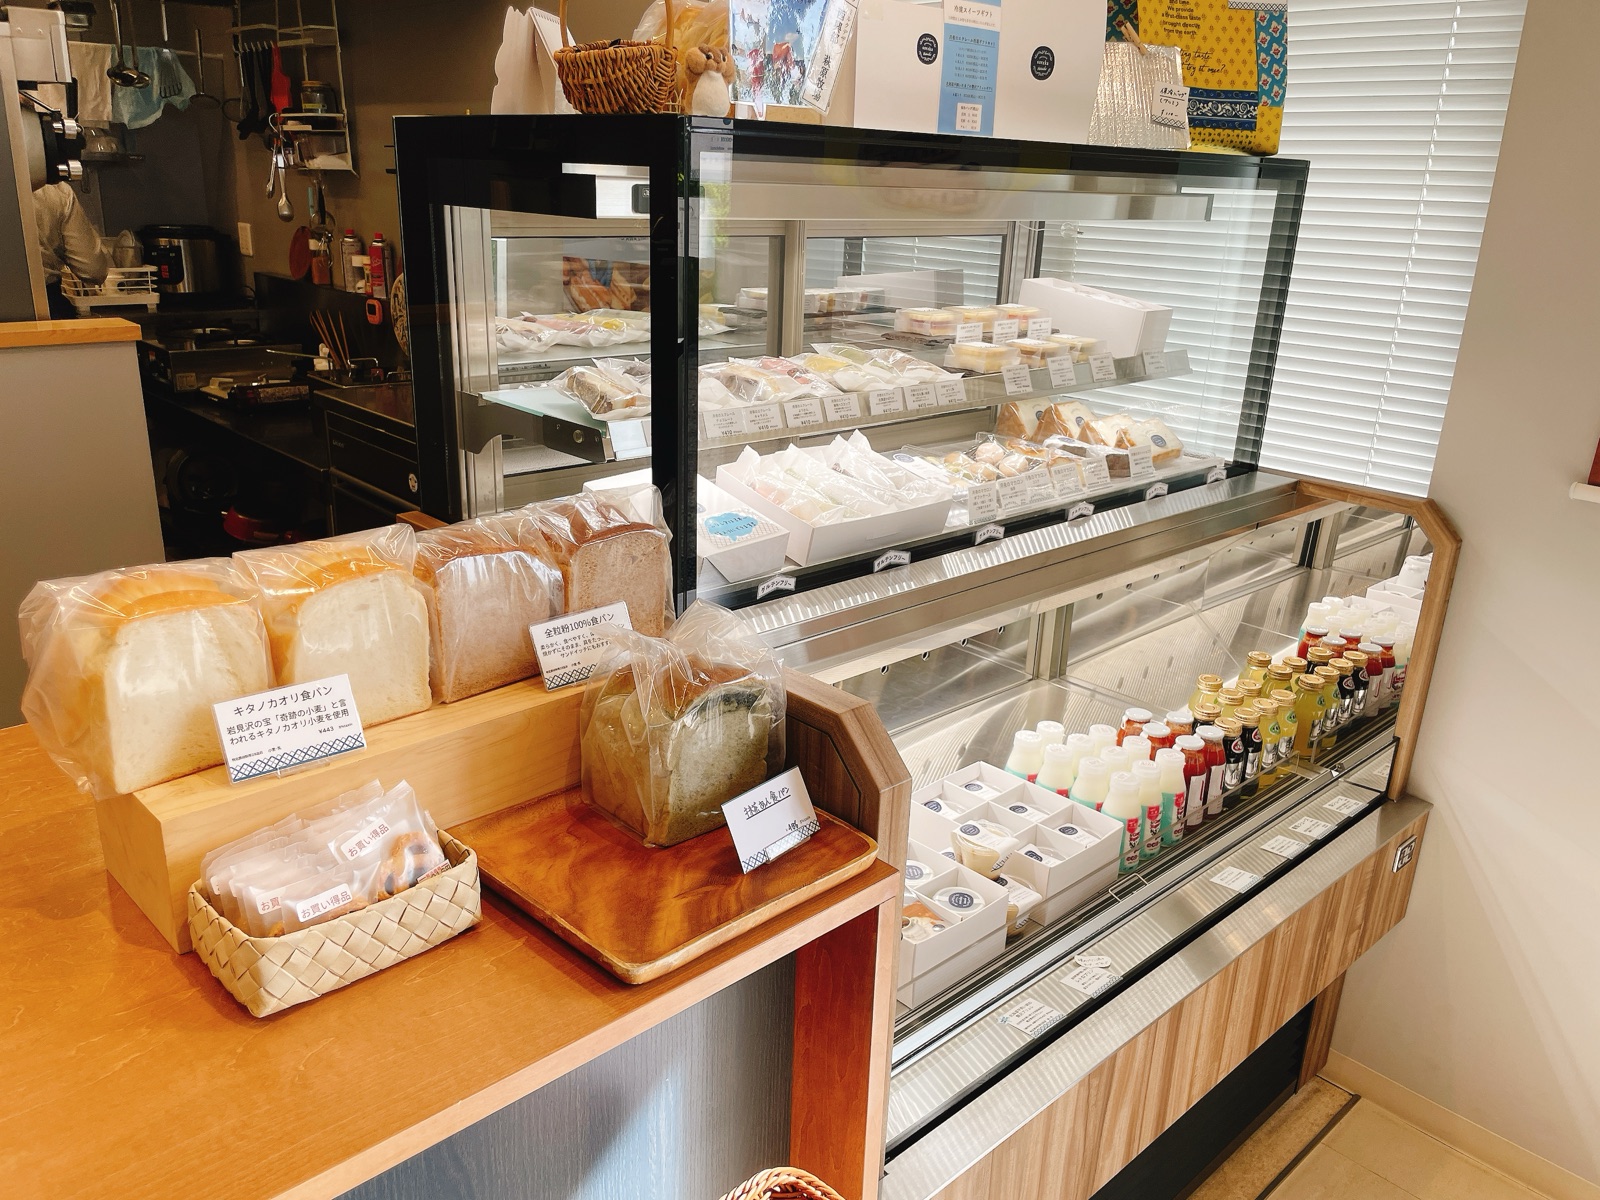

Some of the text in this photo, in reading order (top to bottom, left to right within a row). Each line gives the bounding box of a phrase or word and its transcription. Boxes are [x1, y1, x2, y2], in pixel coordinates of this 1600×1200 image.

[1162, 20, 1181, 28] brought
[544, 612, 615, 639] 全粒粉100%食パン
[233, 685, 333, 716] キタノカオリ食パン
[226, 698, 347, 735] 岩見沢の宝「奇跡の小麦」と言
[230, 708, 350, 746] われるキタノカオリ小麦を使用
[318, 726, 334, 734] ¥443
[348, 823, 390, 858] お買い得品
[301, 891, 352, 920] お買い得品
